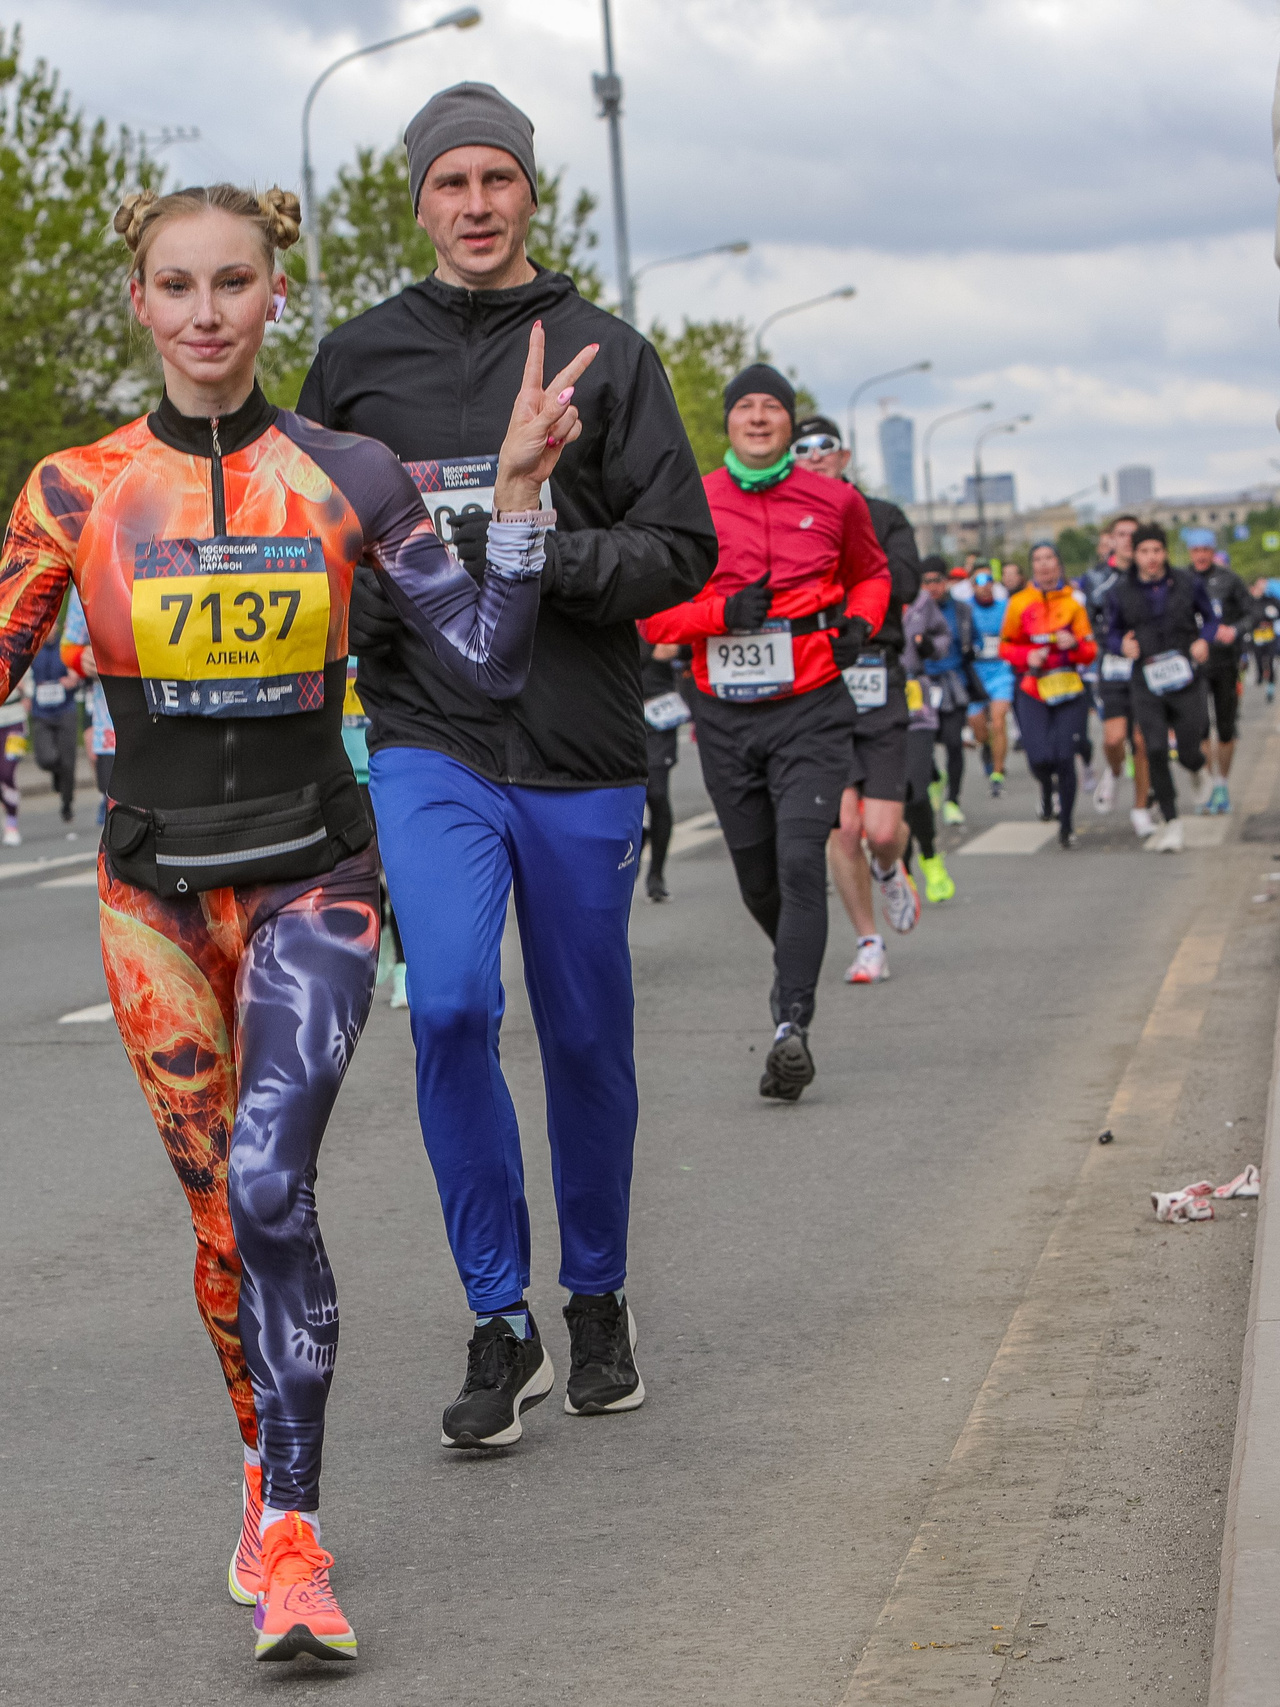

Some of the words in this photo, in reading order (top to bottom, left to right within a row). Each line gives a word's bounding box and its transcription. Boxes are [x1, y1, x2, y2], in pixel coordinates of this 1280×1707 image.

[443, 462, 491, 474] МОСКОВСКИЙ
[445, 478, 480, 488] МАРАФОН
[198, 543, 257, 555] МОСКОВСКИЙ
[200, 554, 222, 563] ПОЛУ
[200, 562, 242, 572] МАРАФОН
[161, 590, 301, 645] 7137
[206, 651, 260, 665] АЛЕНА
[718, 643, 774, 667] 9331
[161, 681, 179, 708] E
